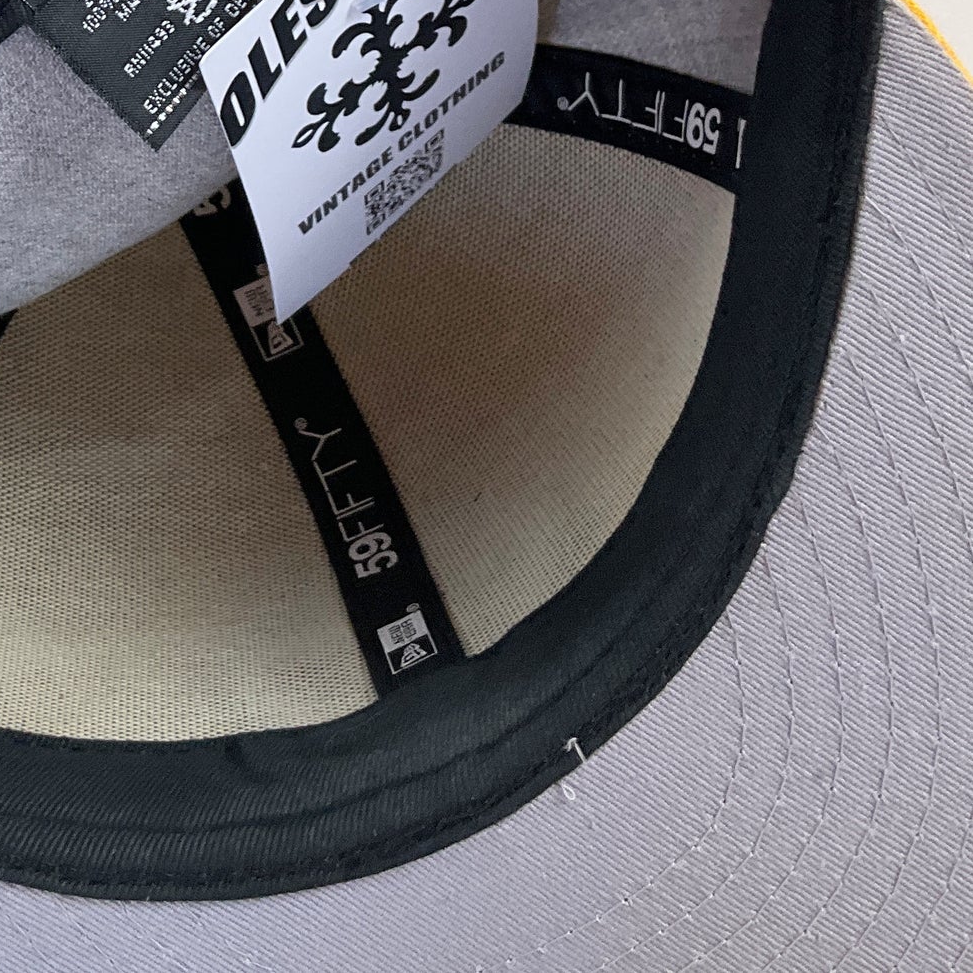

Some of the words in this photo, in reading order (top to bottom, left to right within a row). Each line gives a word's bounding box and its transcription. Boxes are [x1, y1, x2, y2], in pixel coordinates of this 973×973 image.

[144, 37, 210, 114] EXCLUSIVE
[207, 16, 227, 39] OF
[297, 145, 394, 236] VINTAGE
[398, 52, 506, 157] CLOTHING
